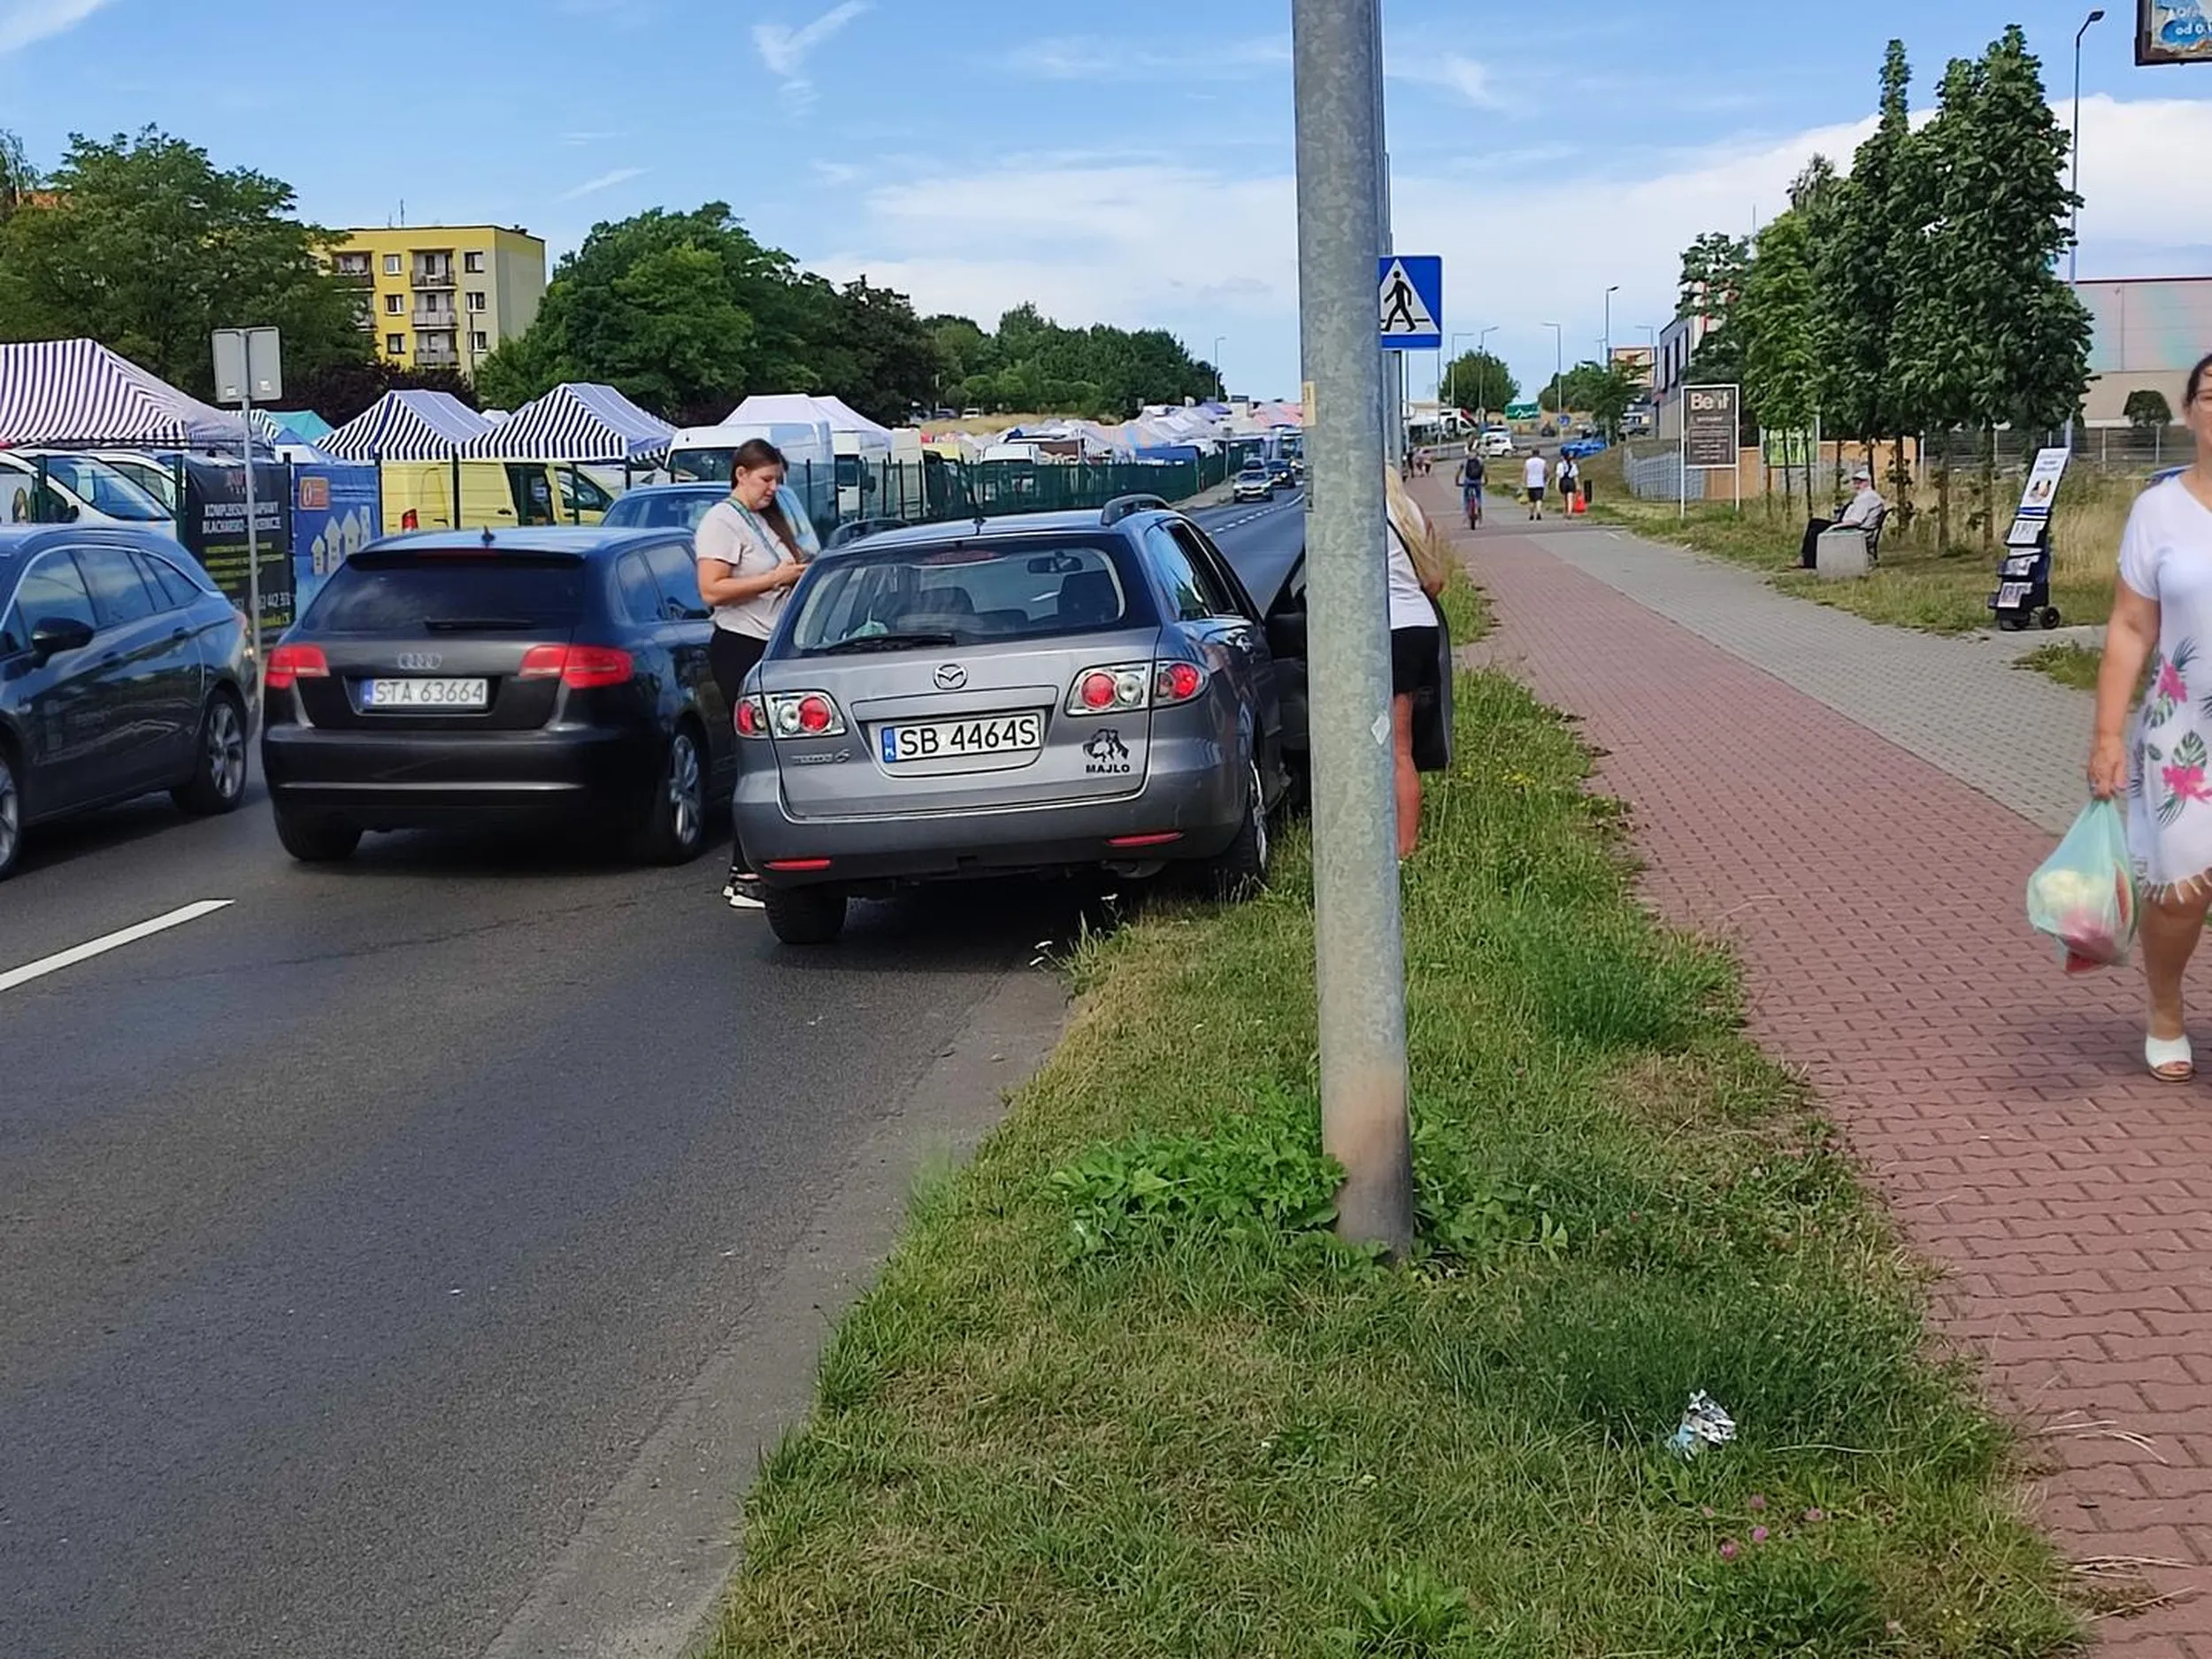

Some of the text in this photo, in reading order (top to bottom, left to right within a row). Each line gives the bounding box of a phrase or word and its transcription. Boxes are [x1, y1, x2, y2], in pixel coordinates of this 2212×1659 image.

[375, 681, 484, 702] STA 63664
[900, 718, 1036, 755] SB 4464S
[1086, 764, 1130, 773] MAJLO
